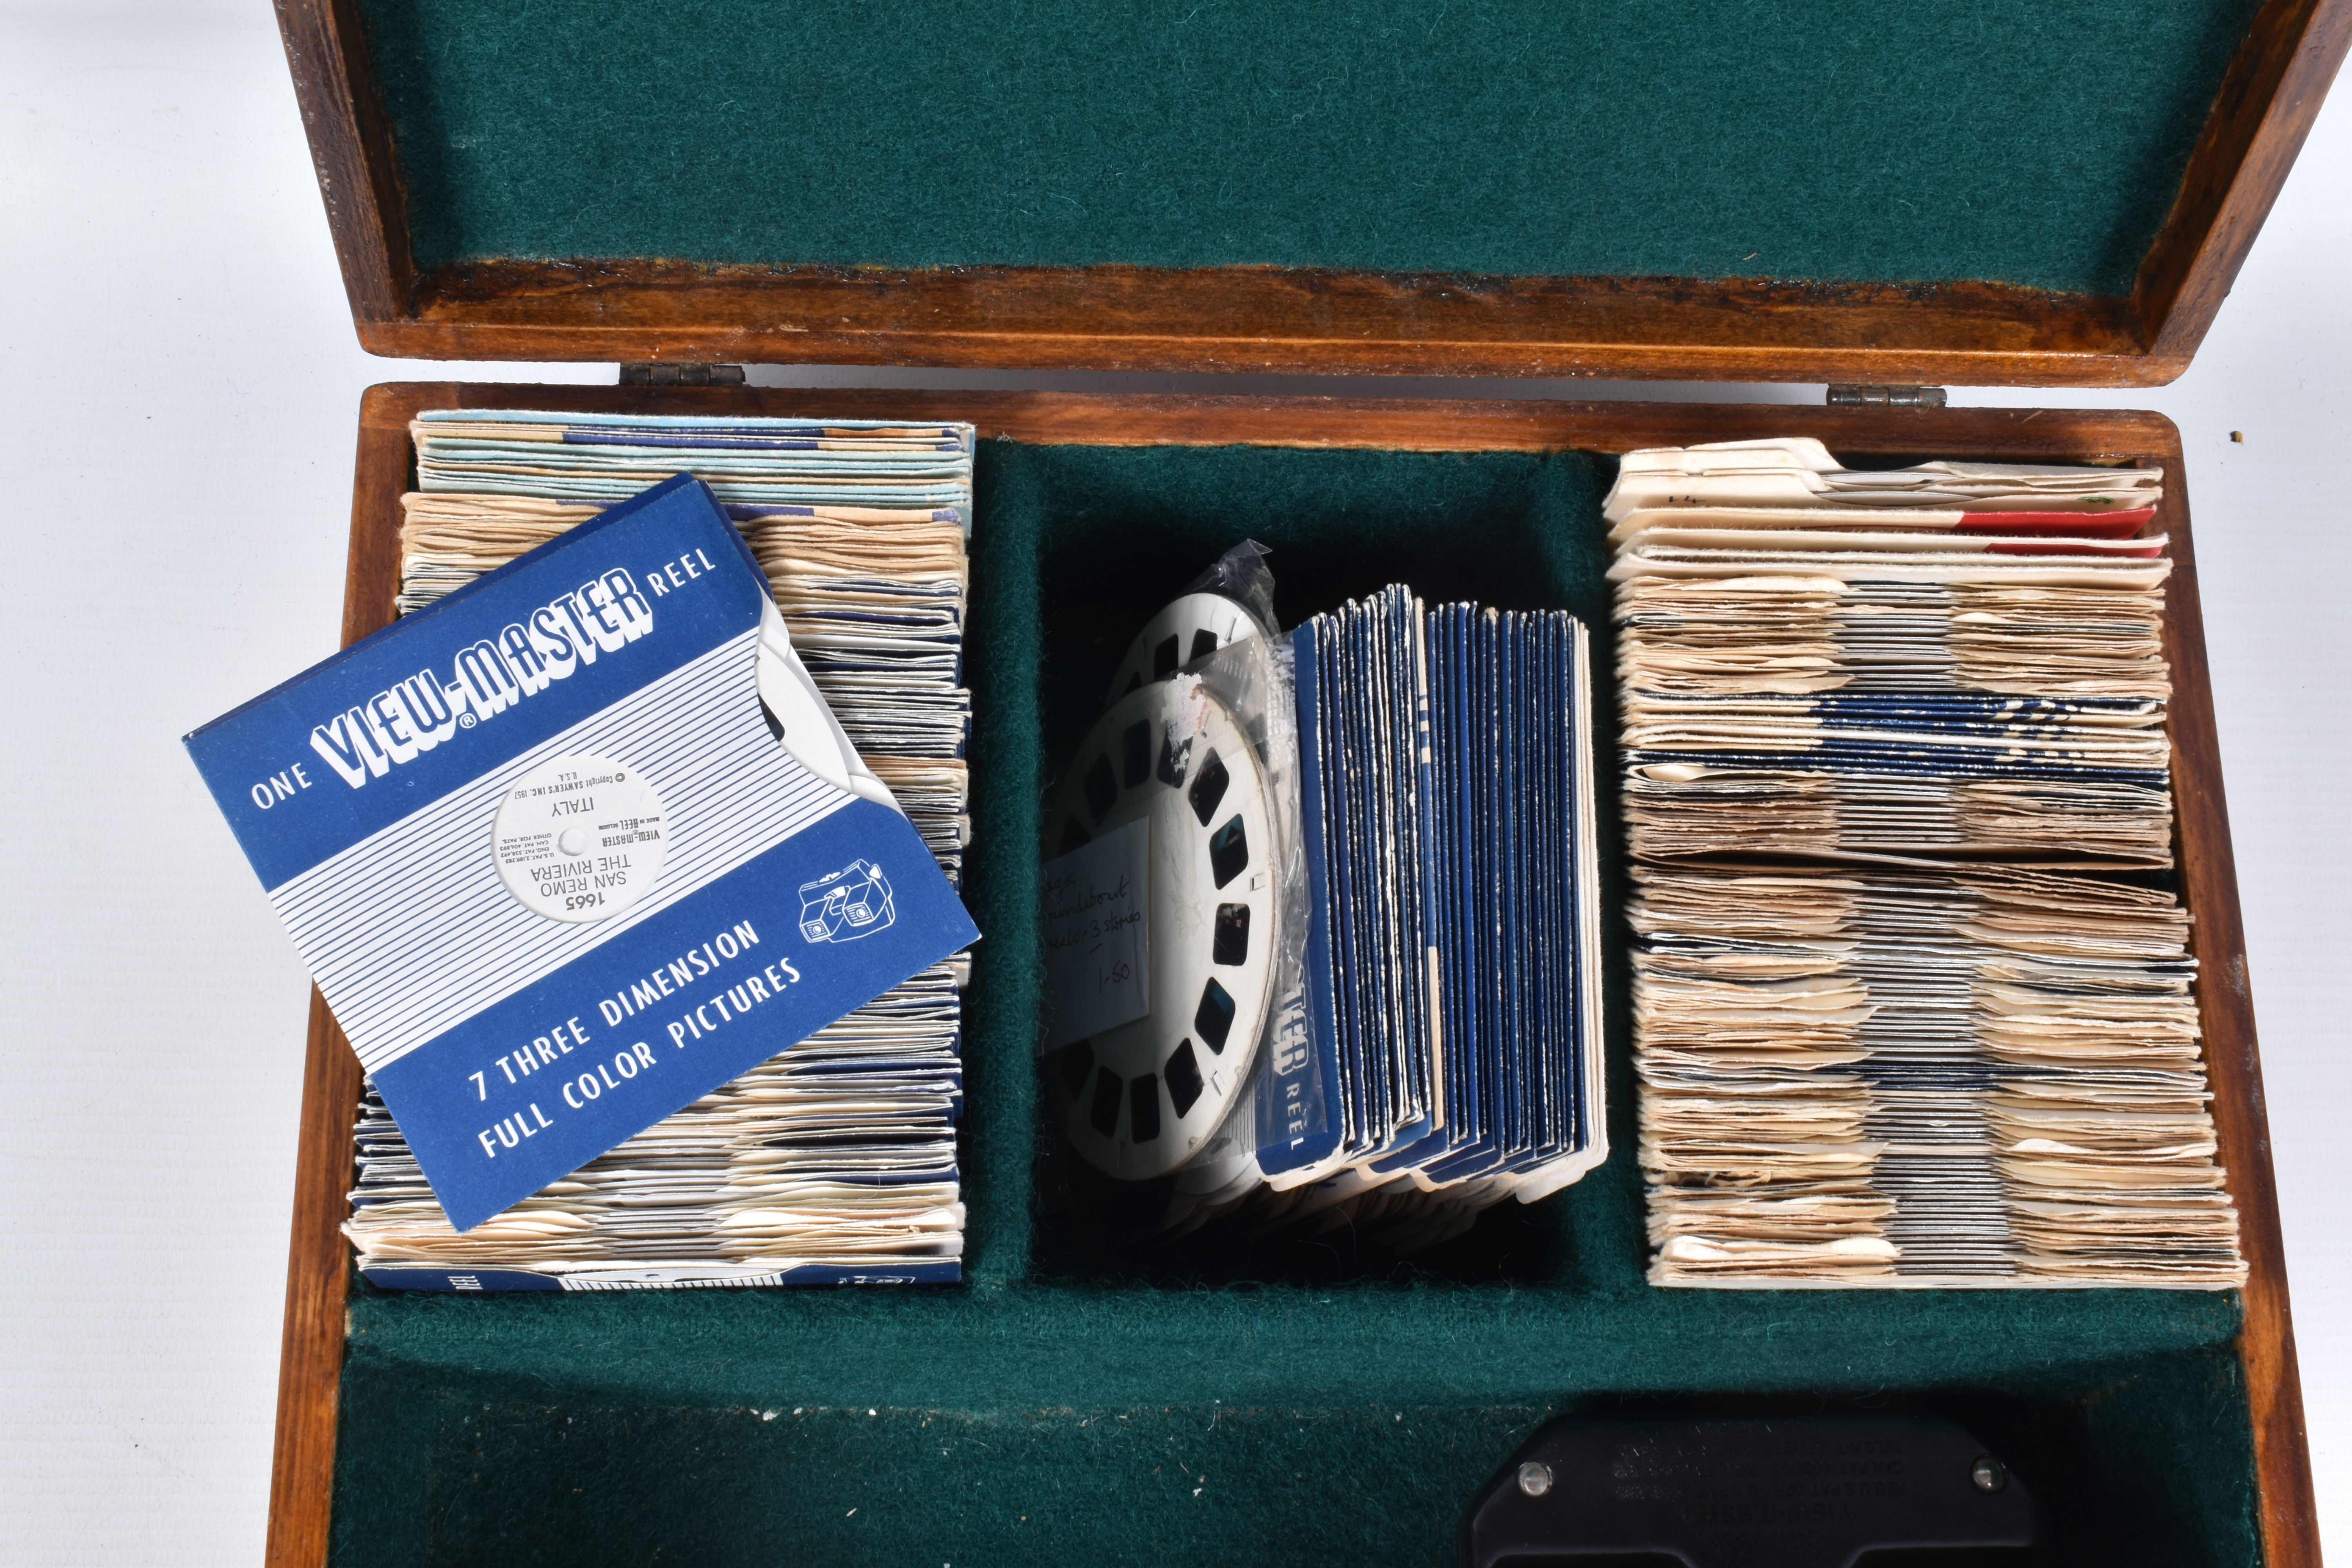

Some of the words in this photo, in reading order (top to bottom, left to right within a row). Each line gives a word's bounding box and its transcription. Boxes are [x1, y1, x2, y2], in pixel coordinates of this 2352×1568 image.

[252, 763, 312, 809] ONE
[310, 567, 653, 789] VIEW-MASTER
[647, 549, 715, 596] REEL
[549, 781, 583, 793] SAWYER'S
[586, 776, 613, 787] Copyright
[515, 790, 527, 799] 1957
[529, 787, 545, 795] INC.
[552, 797, 593, 817] ITALY
[619, 818, 638, 830] REEL
[603, 830, 660, 847] VIEW-MASTER
[531, 860, 592, 881] RIVIERA
[598, 855, 631, 871] THE
[541, 878, 587, 897] REMO
[595, 871, 626, 888] SAN
[566, 892, 605, 910] 1665
[469, 1071, 486, 1101] 7
[495, 1017, 590, 1083] THREE
[599, 920, 759, 1026] DIMENSION
[478, 1103, 553, 1158] FULL
[563, 1042, 657, 1108] COLOR
[668, 958, 800, 1048] PICTURES
[1286, 1083, 1303, 1151] REEL
